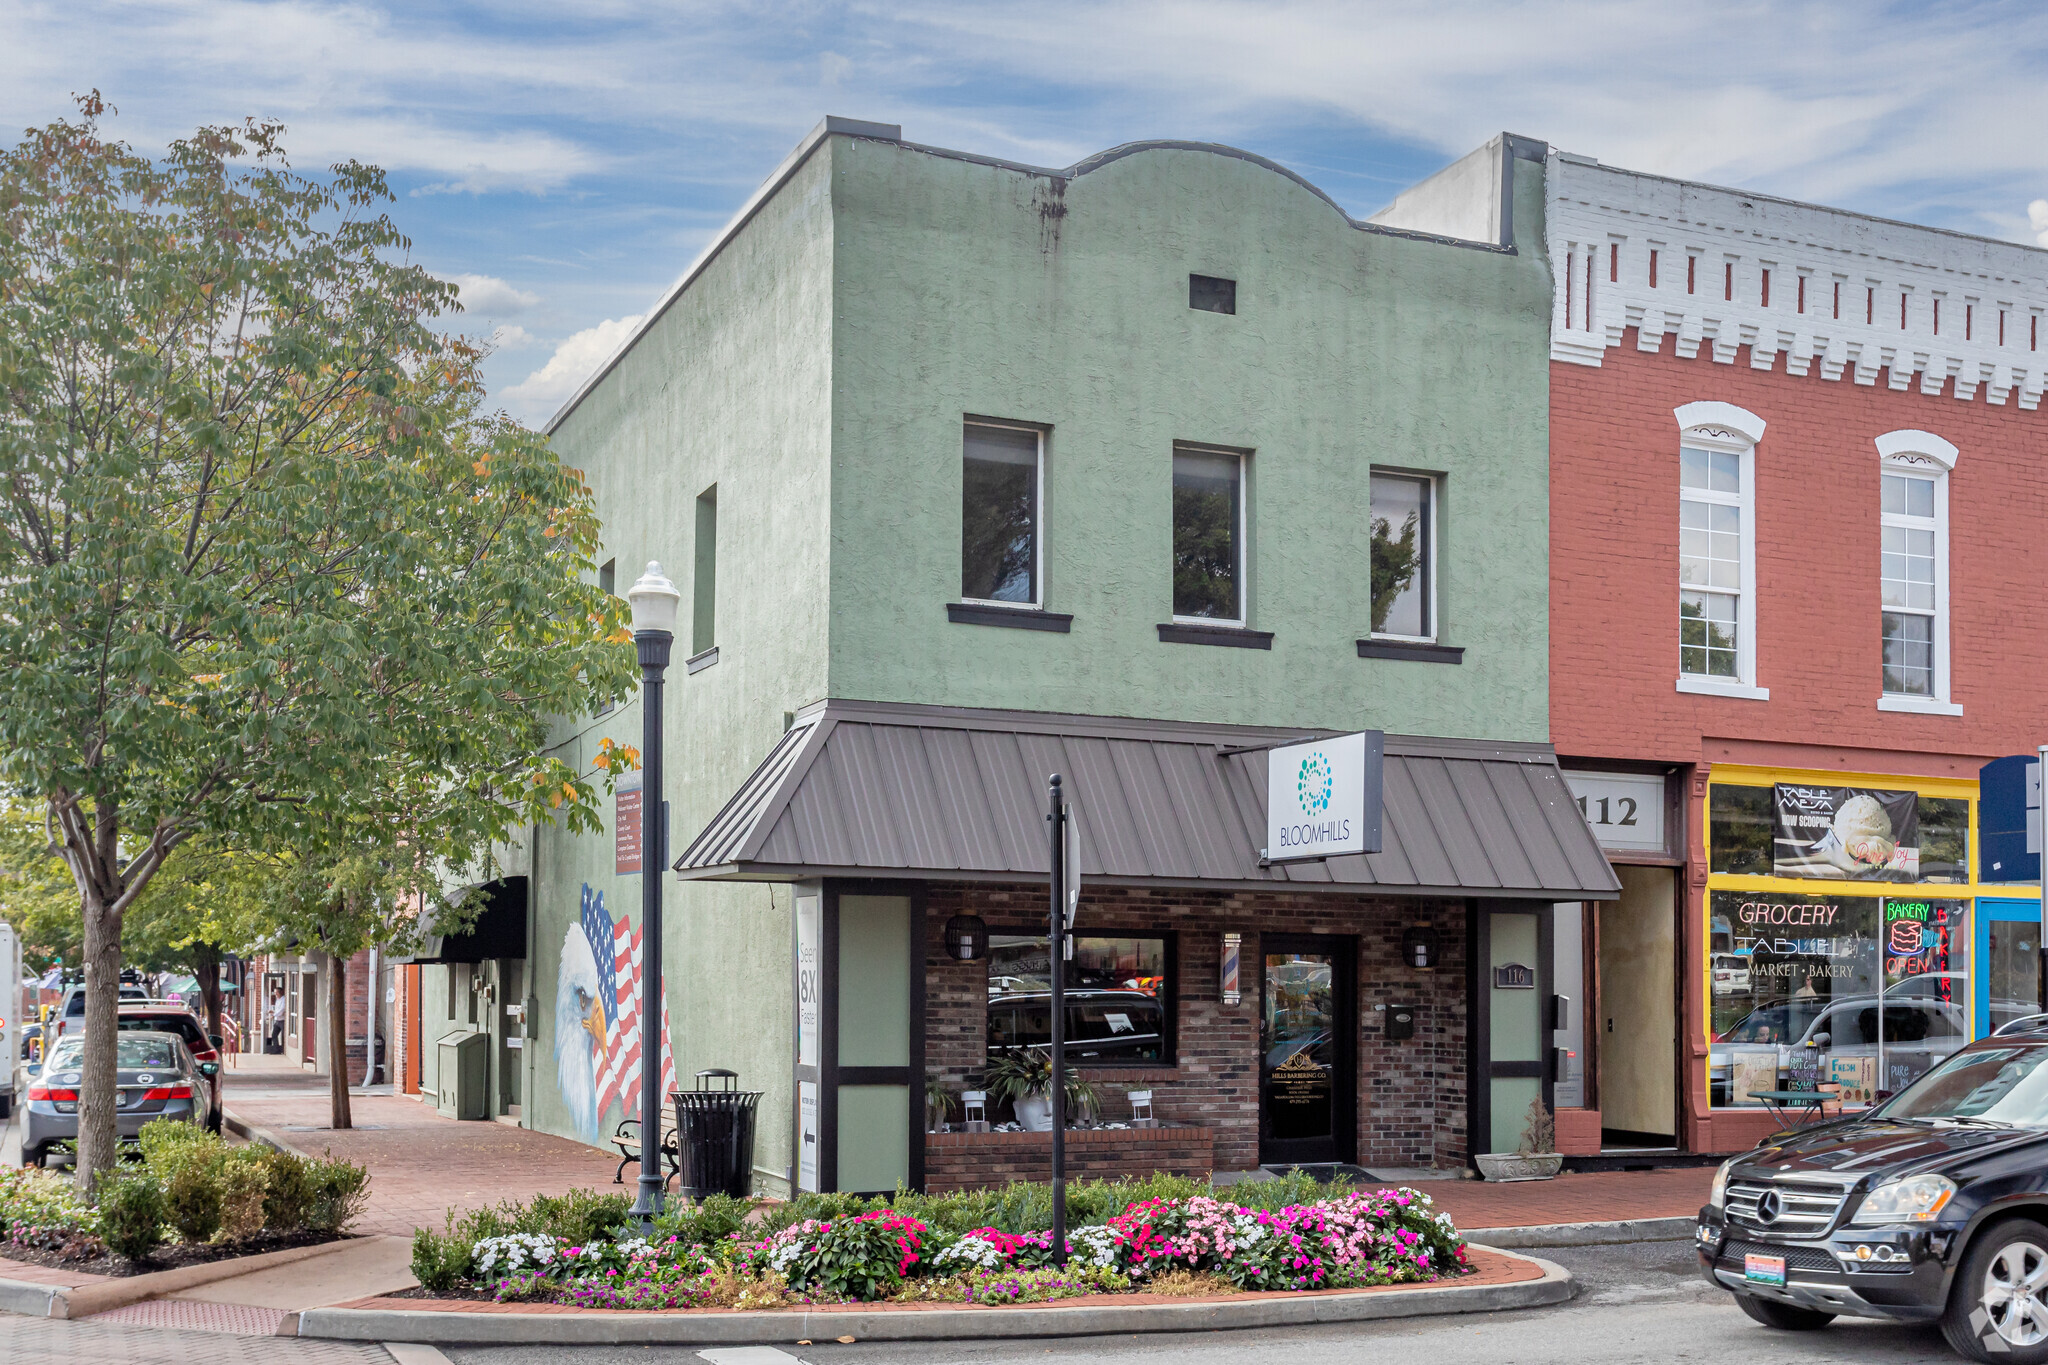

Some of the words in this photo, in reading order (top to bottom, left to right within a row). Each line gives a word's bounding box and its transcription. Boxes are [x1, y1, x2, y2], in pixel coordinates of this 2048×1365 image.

[1779, 786, 1833, 800] TABLE
[1778, 797, 1834, 811] MESA
[1782, 814, 1798, 827] NOW
[1799, 815, 1831, 829] SCOOPING
[1280, 819, 1350, 847] BLOOMHILLS
[1739, 902, 1838, 925] GROCERY
[1887, 902, 1930, 921] BAKERY
[800, 942, 817, 963] Seen
[1734, 936, 1840, 955] TABLE
[1886, 957, 1928, 974] OPEN
[1936, 908, 1951, 1009] BAKERY
[1507, 969, 1525, 984] 116
[1749, 963, 1799, 977] MARKET
[1809, 964, 1855, 978] BAKERY
[801, 969, 817, 1003] 8X
[1832, 1058, 1855, 1072] FRESH
